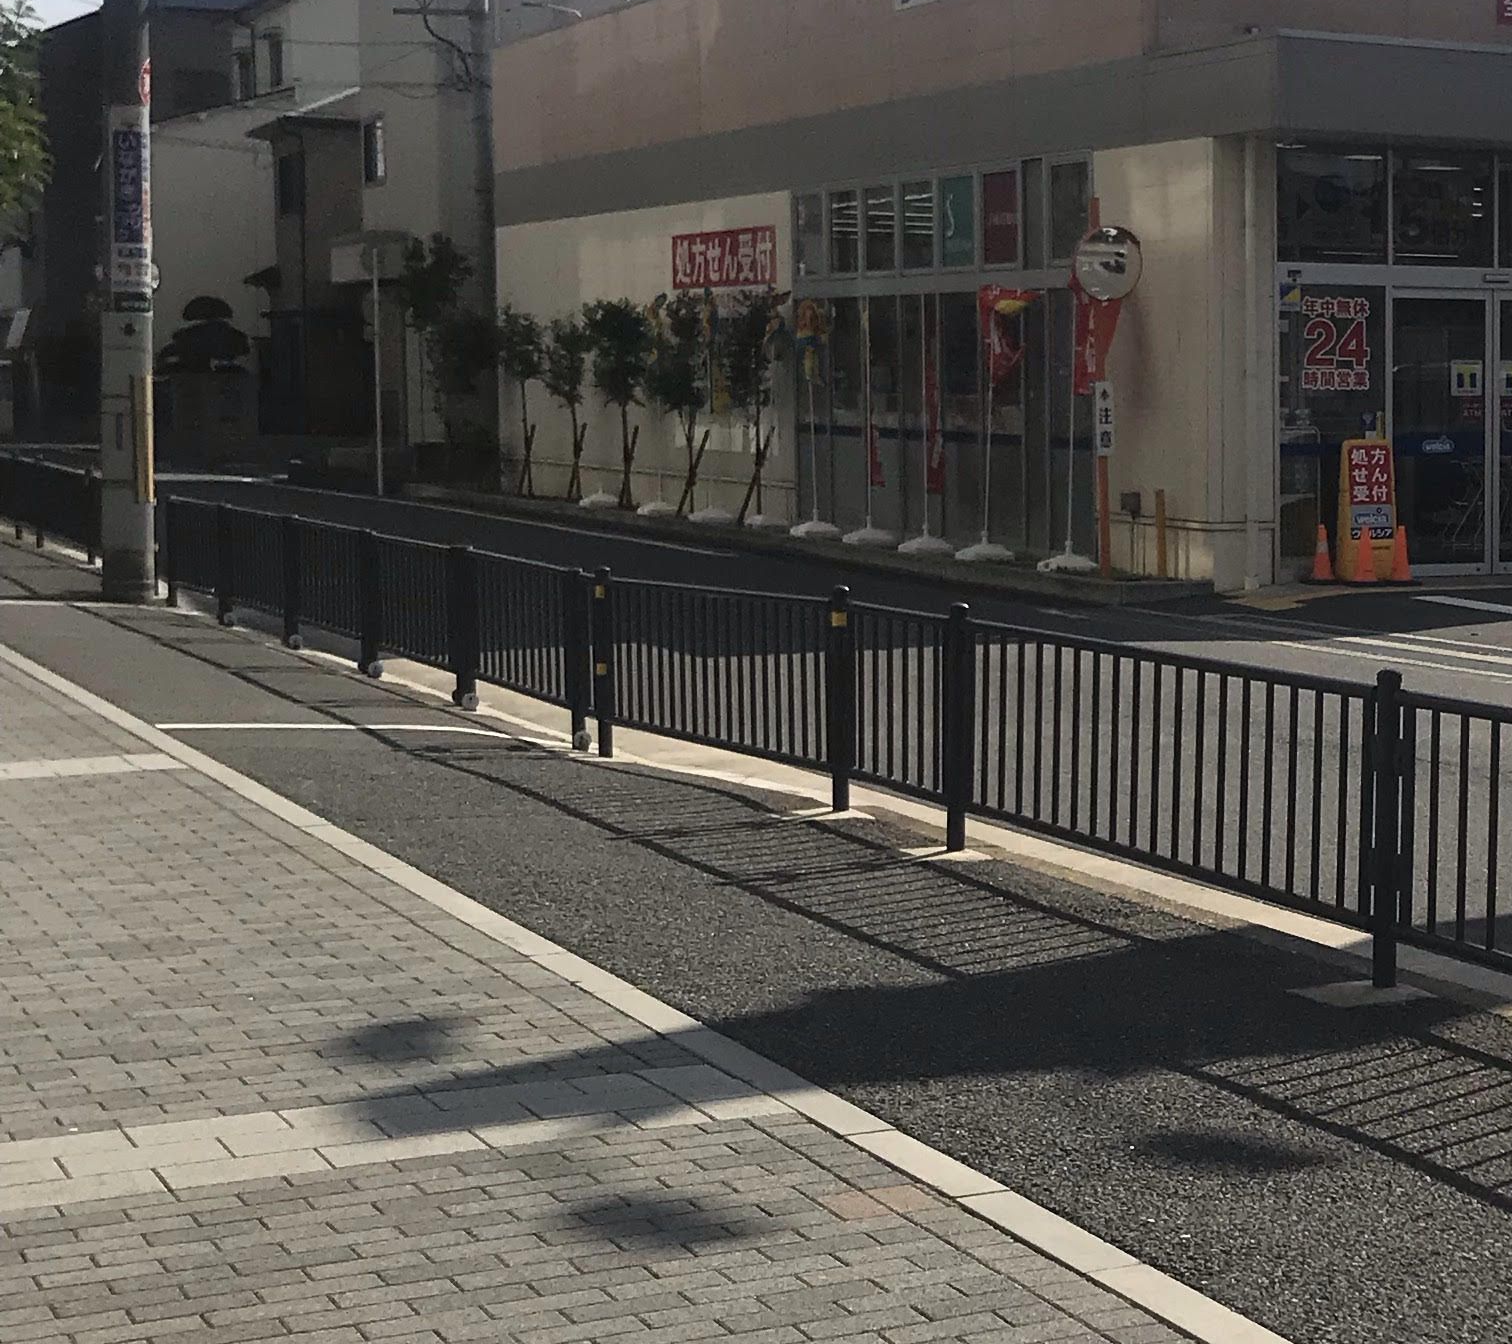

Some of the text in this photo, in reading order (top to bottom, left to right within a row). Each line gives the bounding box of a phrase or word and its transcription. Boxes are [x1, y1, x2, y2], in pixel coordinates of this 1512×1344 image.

[676, 231, 772, 285] 処方せん受付
[1302, 297, 1370, 318] 年中無休
[1304, 319, 1370, 369] 24
[1302, 369, 1370, 391] 時間営業
[1351, 448, 1386, 465] 処方
[1352, 467, 1387, 483] せん
[1353, 485, 1388, 502] 受付
[1352, 528, 1393, 538] ウルシア
